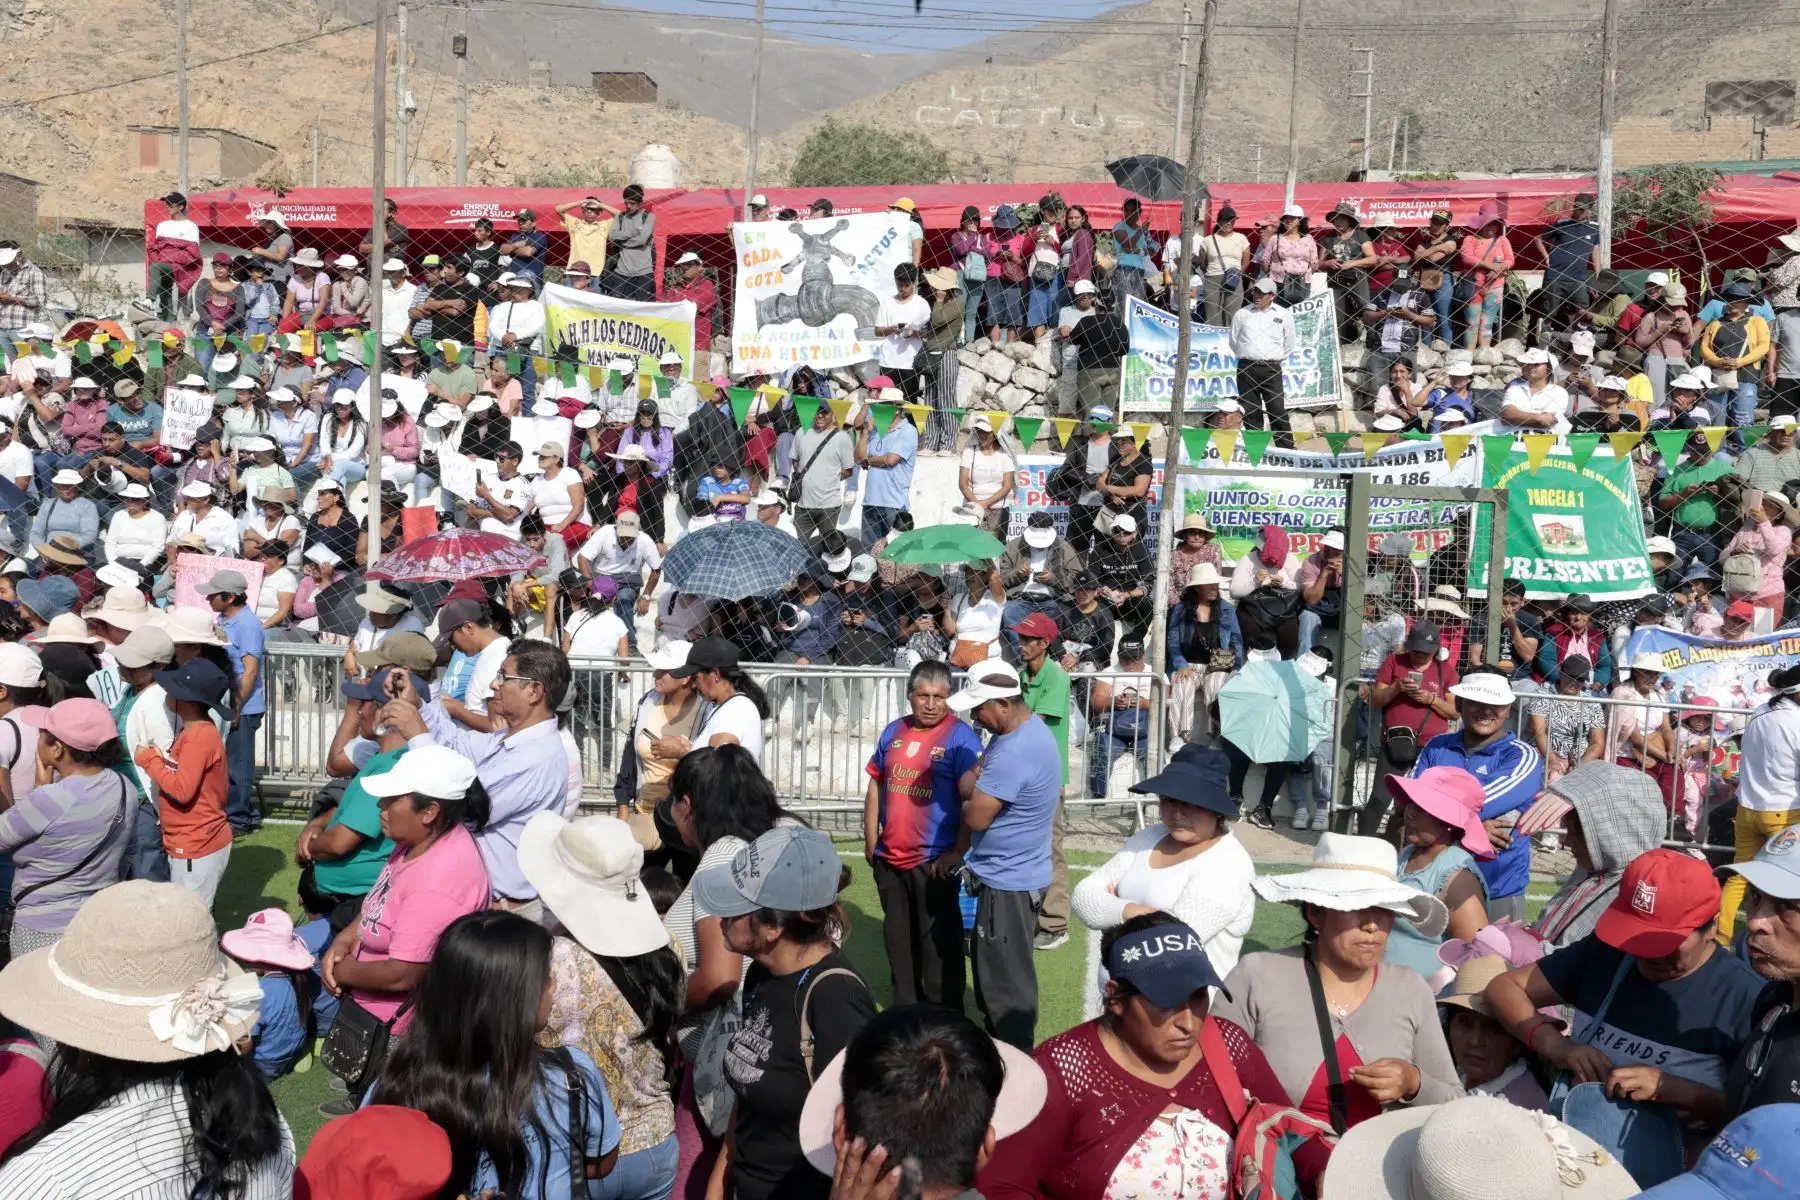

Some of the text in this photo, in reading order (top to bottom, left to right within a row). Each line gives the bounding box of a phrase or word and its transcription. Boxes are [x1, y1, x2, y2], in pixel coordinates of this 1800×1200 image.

[450, 209, 488, 217] CABRERA
[743, 248, 783, 267] CADA
[593, 318, 616, 345] LOS
[618, 320, 667, 359] CEDROS
[738, 345, 772, 361] UNA
[1298, 457, 1324, 469] DE
[1399, 472, 1431, 486] 186
[1206, 491, 1270, 508] JUNTOS
[1527, 489, 1575, 508] PARCELA
[1212, 511, 1305, 526] BIENESTAR
[1312, 512, 1338, 526] DE
[892, 763, 920, 781] Qatar
[1141, 933, 1203, 958] USA
